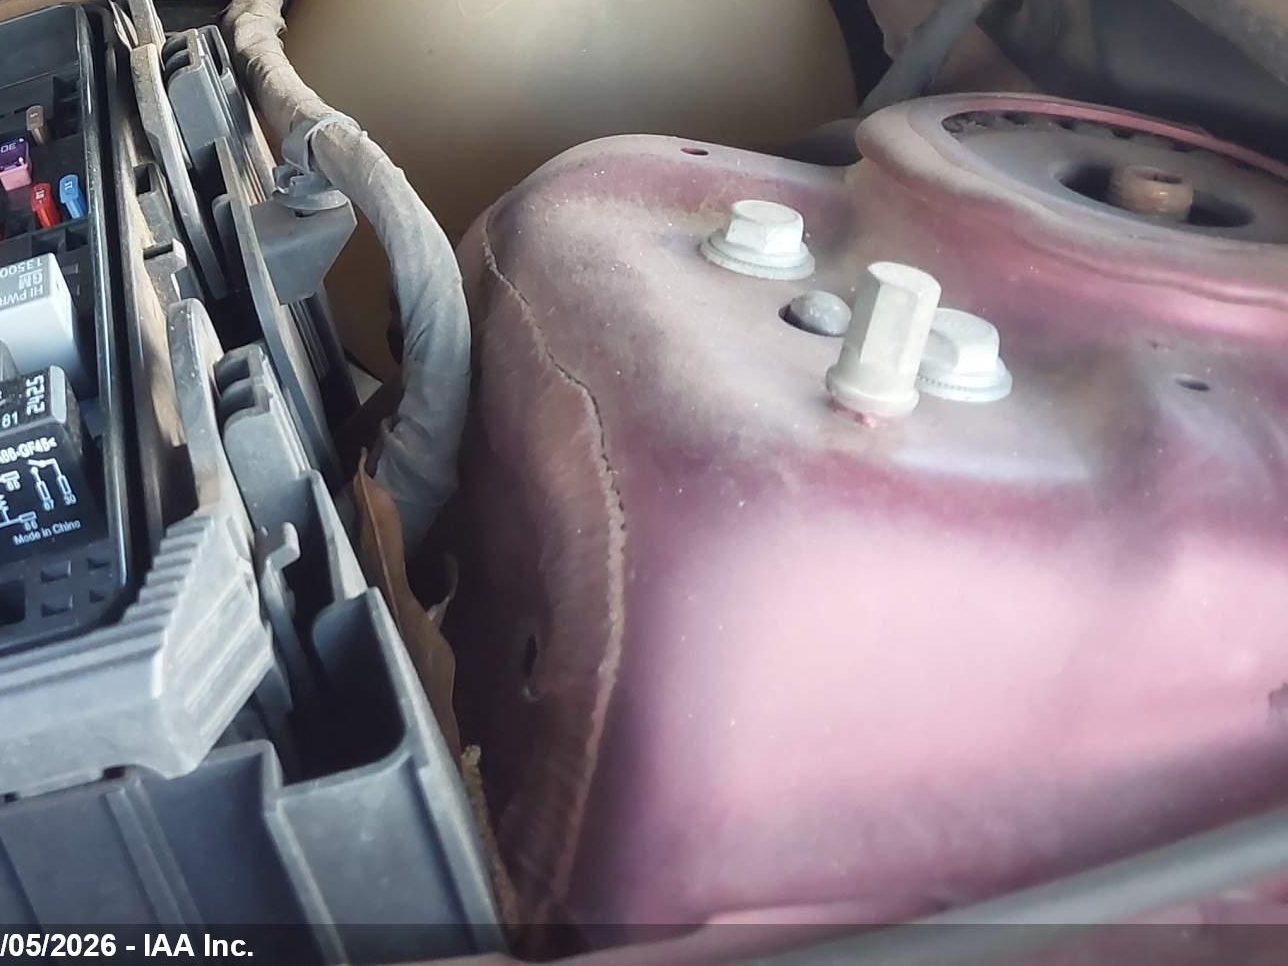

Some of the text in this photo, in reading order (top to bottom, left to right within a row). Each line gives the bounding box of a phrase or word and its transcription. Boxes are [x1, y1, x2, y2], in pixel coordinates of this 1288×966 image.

[18, 269, 43, 290] GM
[0, 288, 27, 307] PWR
[12, 530, 41, 545] Made
[41, 527, 52, 538] in
